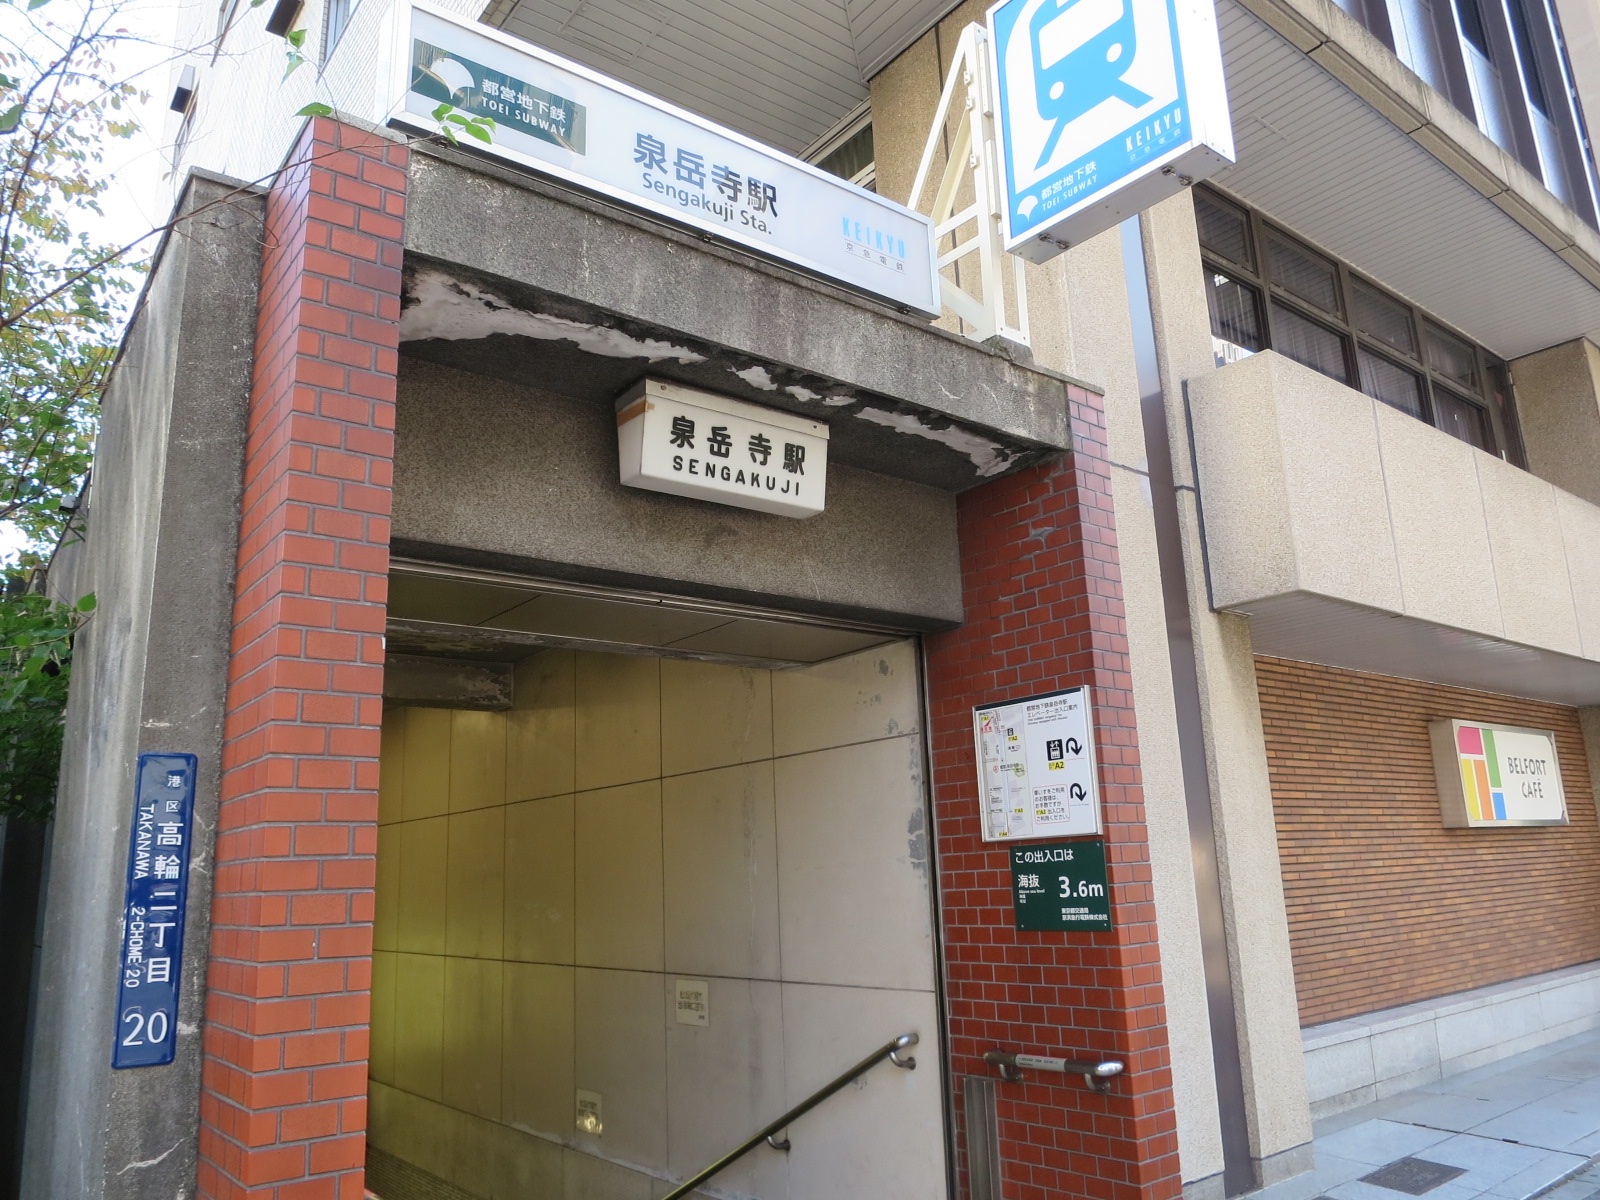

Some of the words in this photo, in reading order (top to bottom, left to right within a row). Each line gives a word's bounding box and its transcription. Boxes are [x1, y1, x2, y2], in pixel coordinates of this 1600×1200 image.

[481, 78, 567, 124] 都営地下鉄
[481, 96, 511, 116] TOEI
[515, 108, 567, 137] SUBWAY
[1125, 107, 1182, 153] KEIKYU
[633, 131, 779, 219] 泉岳寺駅
[1041, 160, 1097, 200] 都営地下鉄
[1042, 197, 1060, 211] TOEI
[1063, 174, 1098, 200] SUBWAY
[642, 172, 735, 222] Sengakuji
[740, 209, 773, 235] Sta.
[842, 216, 906, 259] KEIKYU
[669, 415, 806, 476] 泉岳寺駅
[672, 455, 800, 497] SENGAKUJI
[1055, 761, 1065, 770] A2
[1507, 756, 1548, 776] BELFORT
[165, 774, 182, 813] 港区
[134, 803, 155, 881] TAKANAWA
[1015, 849, 1075, 864] この出入口は
[1017, 873, 1040, 888] 海抜
[1058, 875, 1104, 898] 3.6m
[147, 820, 184, 985] 高輪二丁目
[127, 906, 146, 965] 2-CHOME
[125, 968, 140, 989] 20
[122, 1010, 169, 1048] 20
